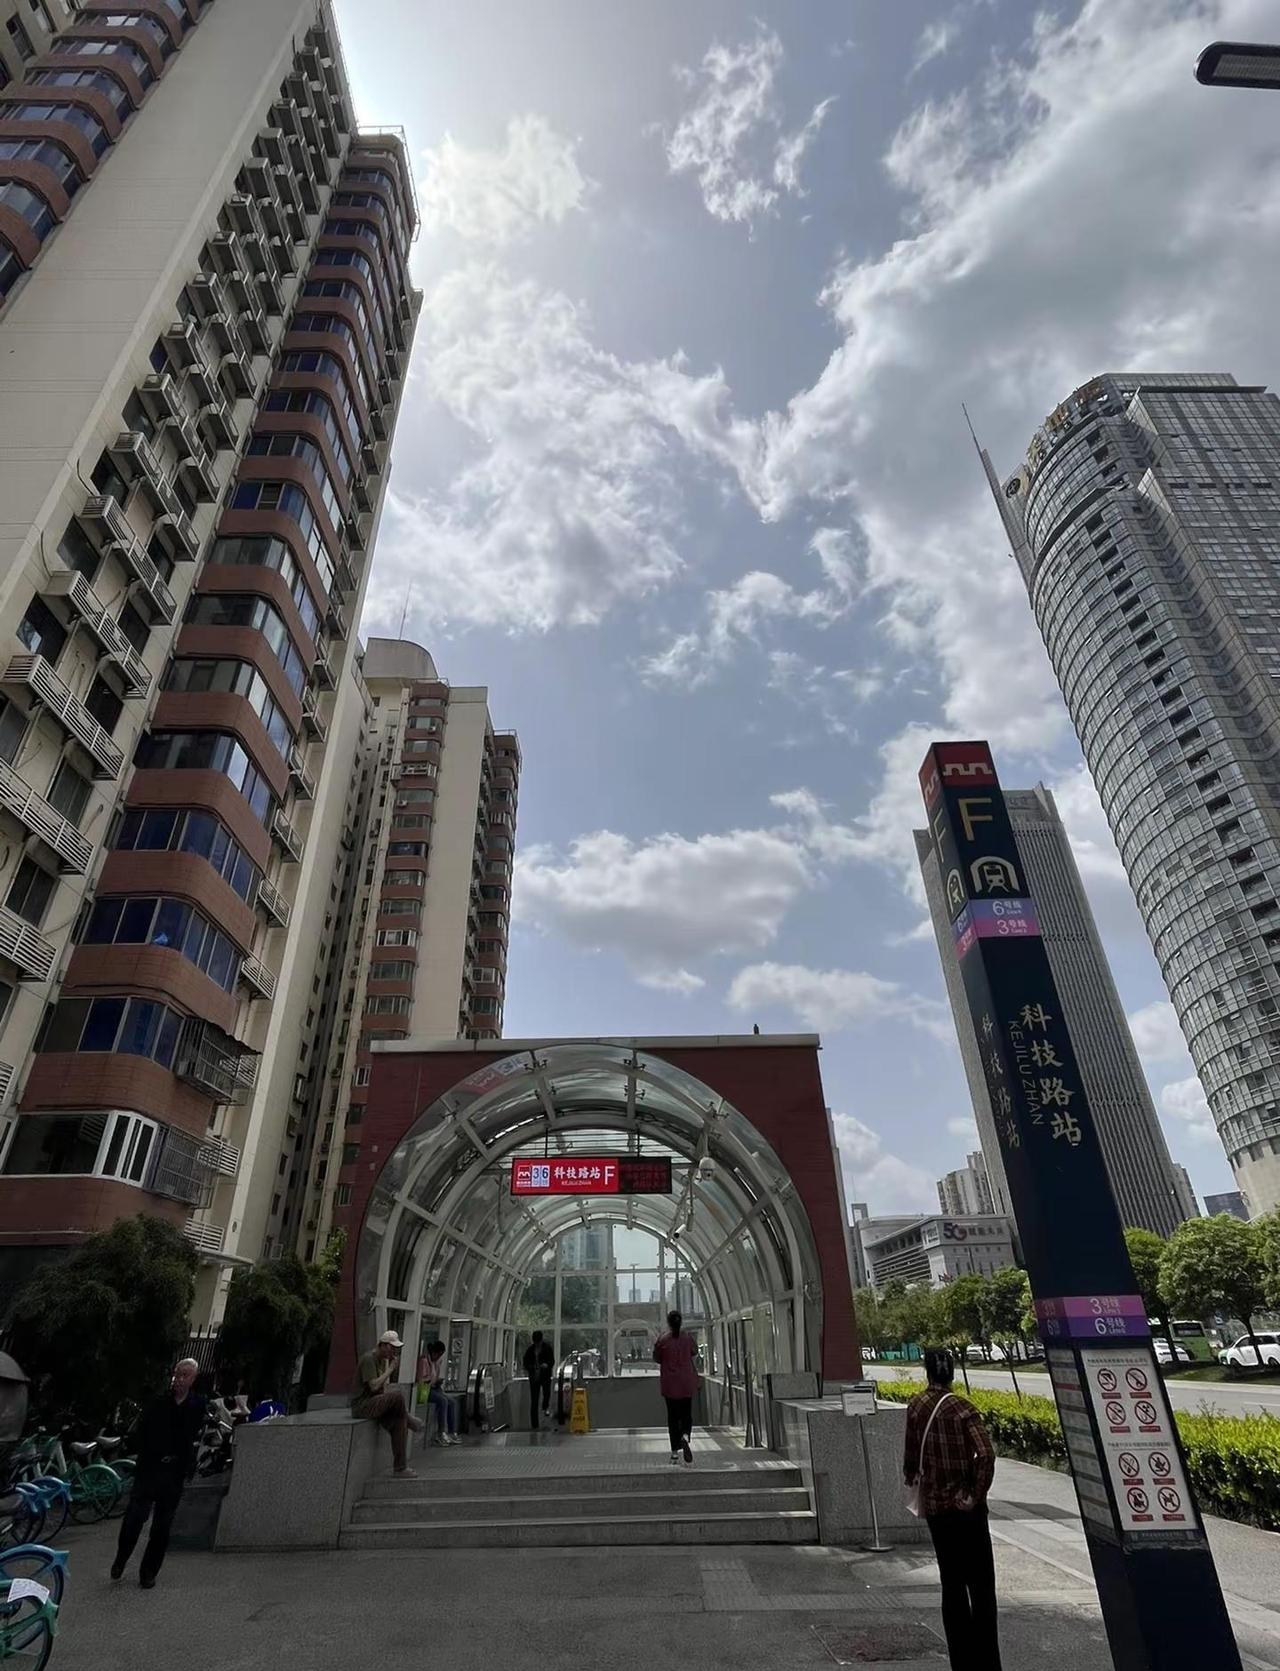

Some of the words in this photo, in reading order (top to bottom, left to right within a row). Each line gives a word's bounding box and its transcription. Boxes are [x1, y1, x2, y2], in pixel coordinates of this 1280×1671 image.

[958, 798, 993, 841] F
[1008, 1020, 1032, 1075] KEJILU
[1022, 1079, 1044, 1125] ZHAN
[1019, 1003, 1082, 1146] 科技路站
[554, 1166, 601, 1179] 科技路站
[604, 1165, 616, 1185] F
